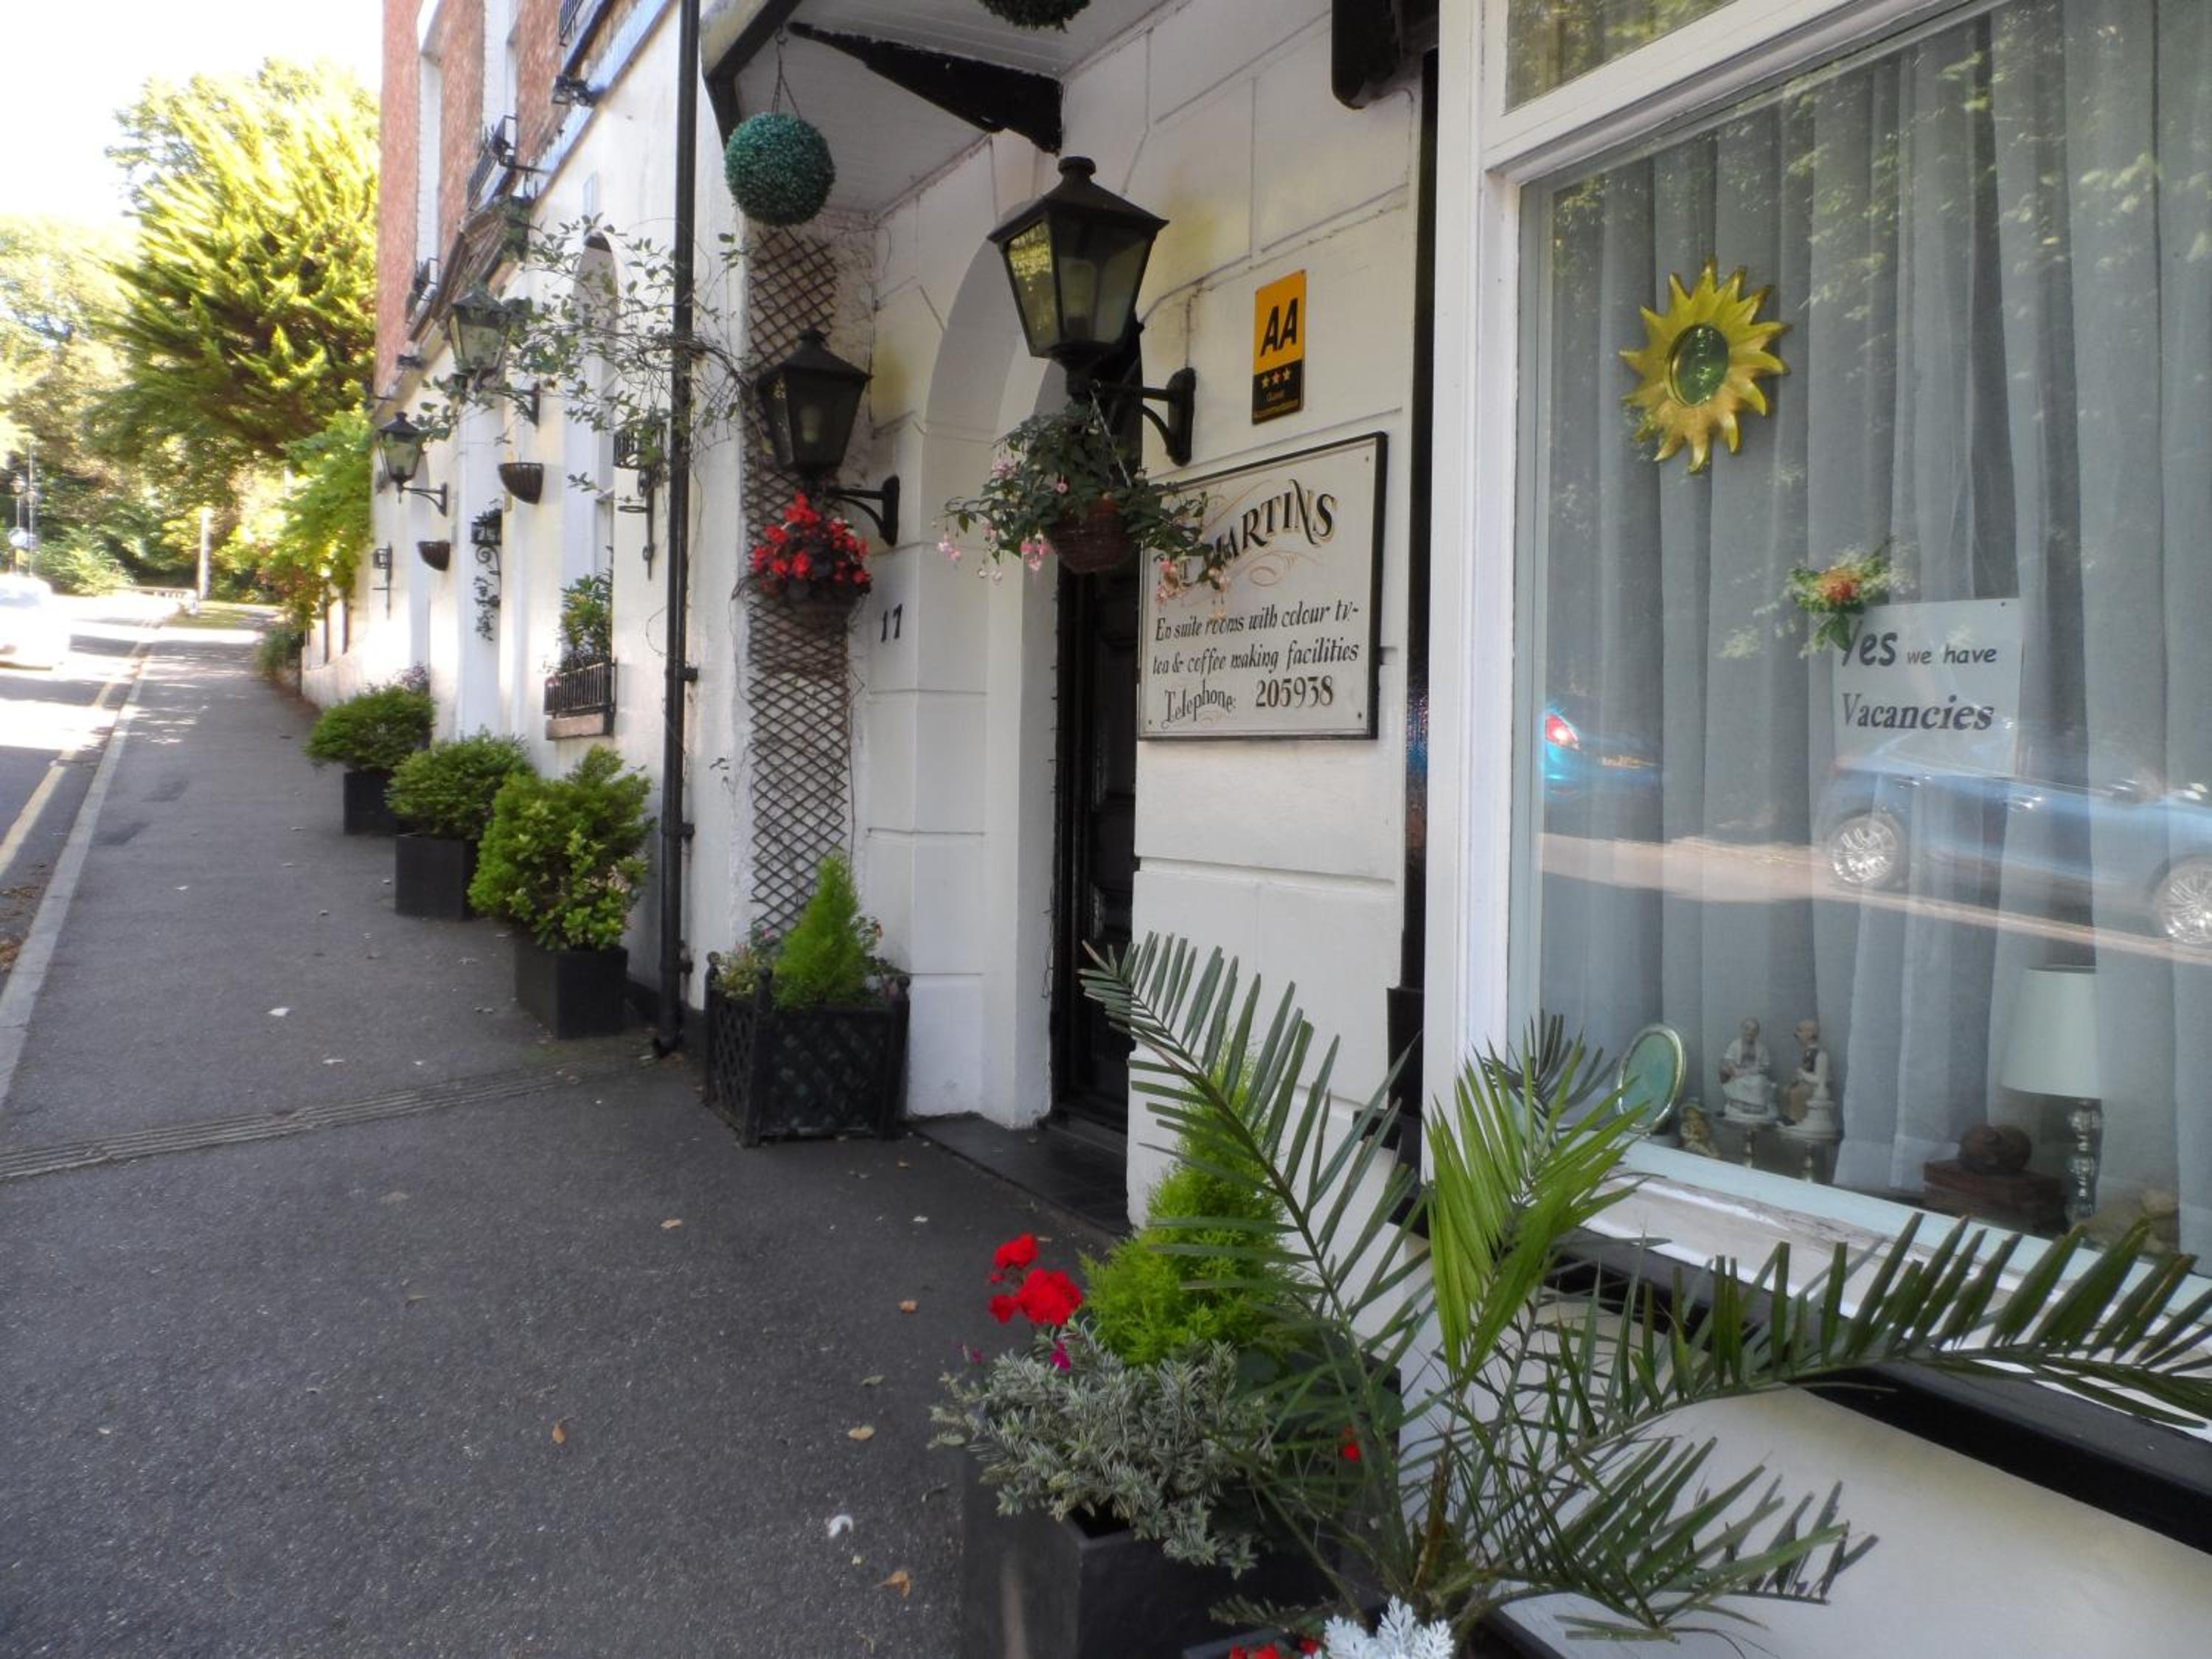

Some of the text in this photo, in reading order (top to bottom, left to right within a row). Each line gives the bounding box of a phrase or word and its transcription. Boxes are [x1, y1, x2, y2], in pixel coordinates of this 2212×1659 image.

[1259, 298, 1298, 357] AA
[1155, 616, 1172, 641] En
[1173, 615, 1203, 639] suite
[1205, 616, 1245, 636] rooms
[1248, 604, 1278, 630] with
[1281, 601, 1331, 627] colour
[1152, 636, 1360, 676] tea & coffee making facilities
[1843, 620, 1997, 667] Yes we have
[1256, 675, 1334, 709] 205938
[1842, 692, 1994, 731] Vacancies
